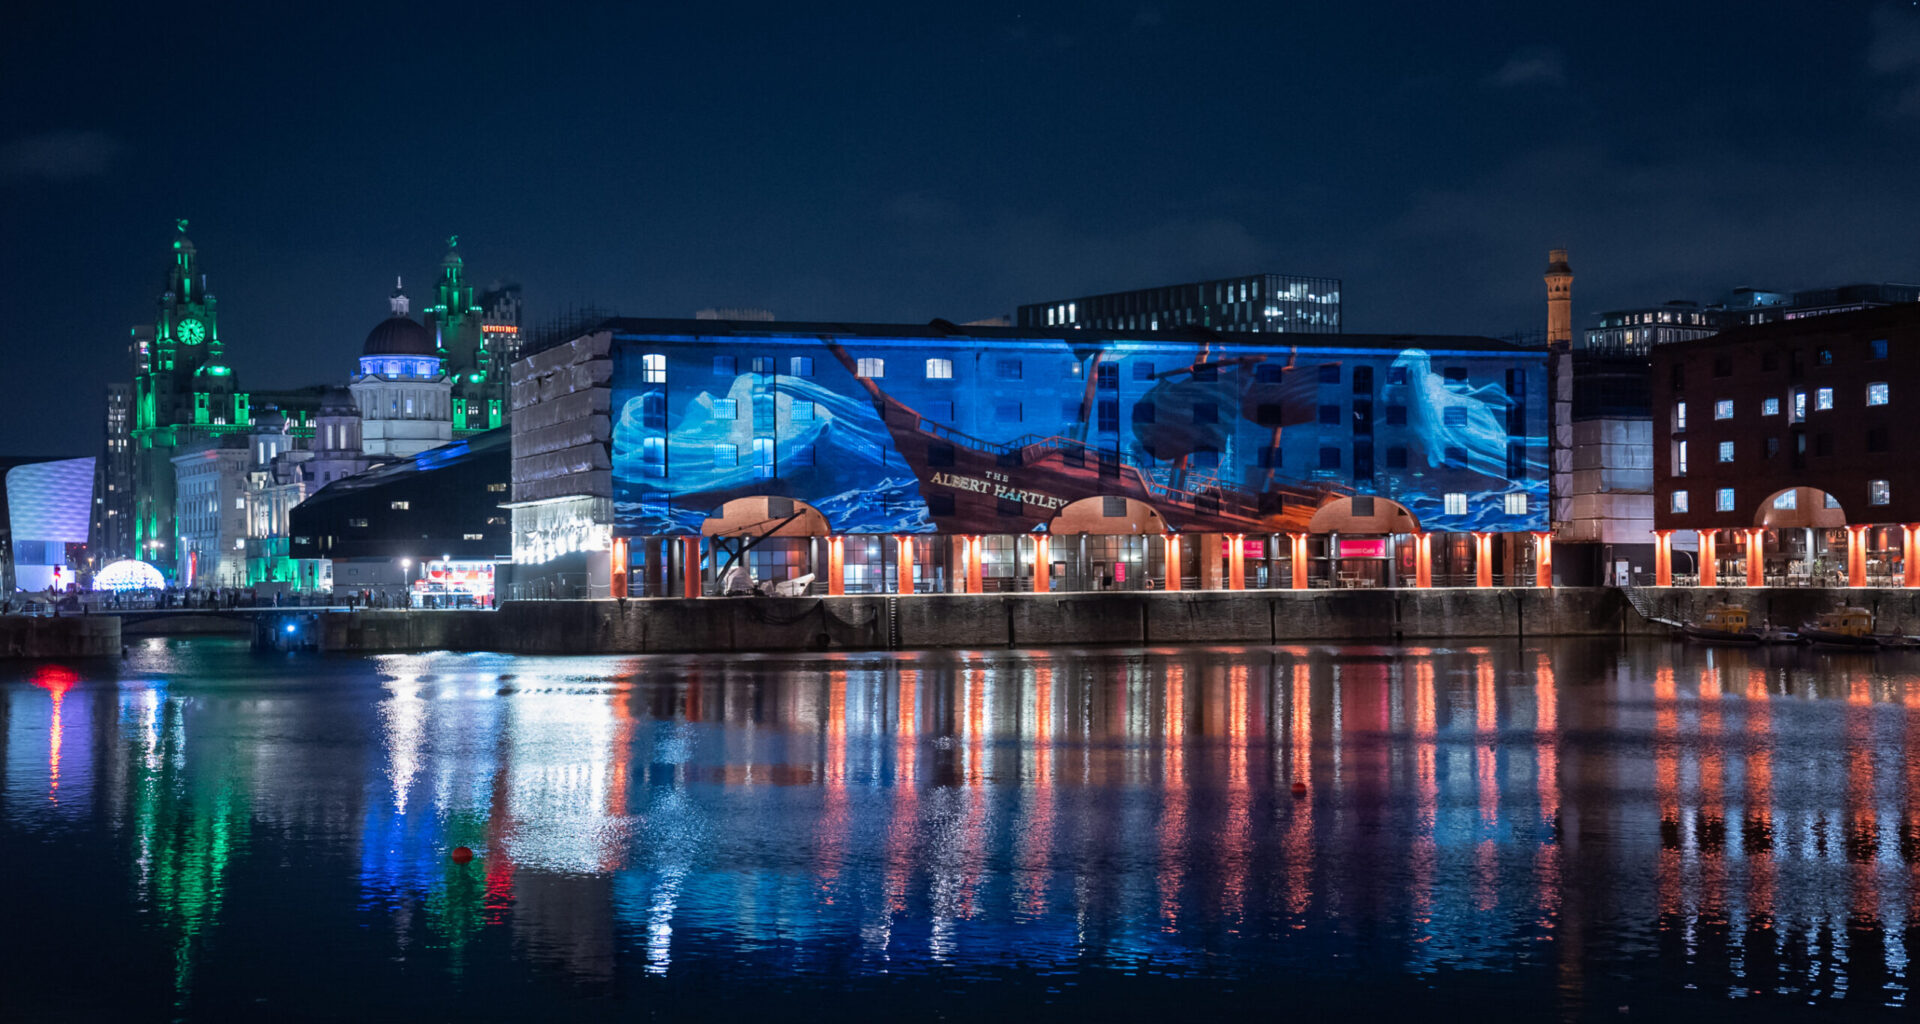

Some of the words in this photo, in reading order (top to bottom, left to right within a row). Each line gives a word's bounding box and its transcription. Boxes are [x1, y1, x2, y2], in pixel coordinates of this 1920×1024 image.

[985, 471, 1009, 482] THE
[930, 472, 991, 494] ALBERT
[993, 484, 1069, 509] HARTLEY
